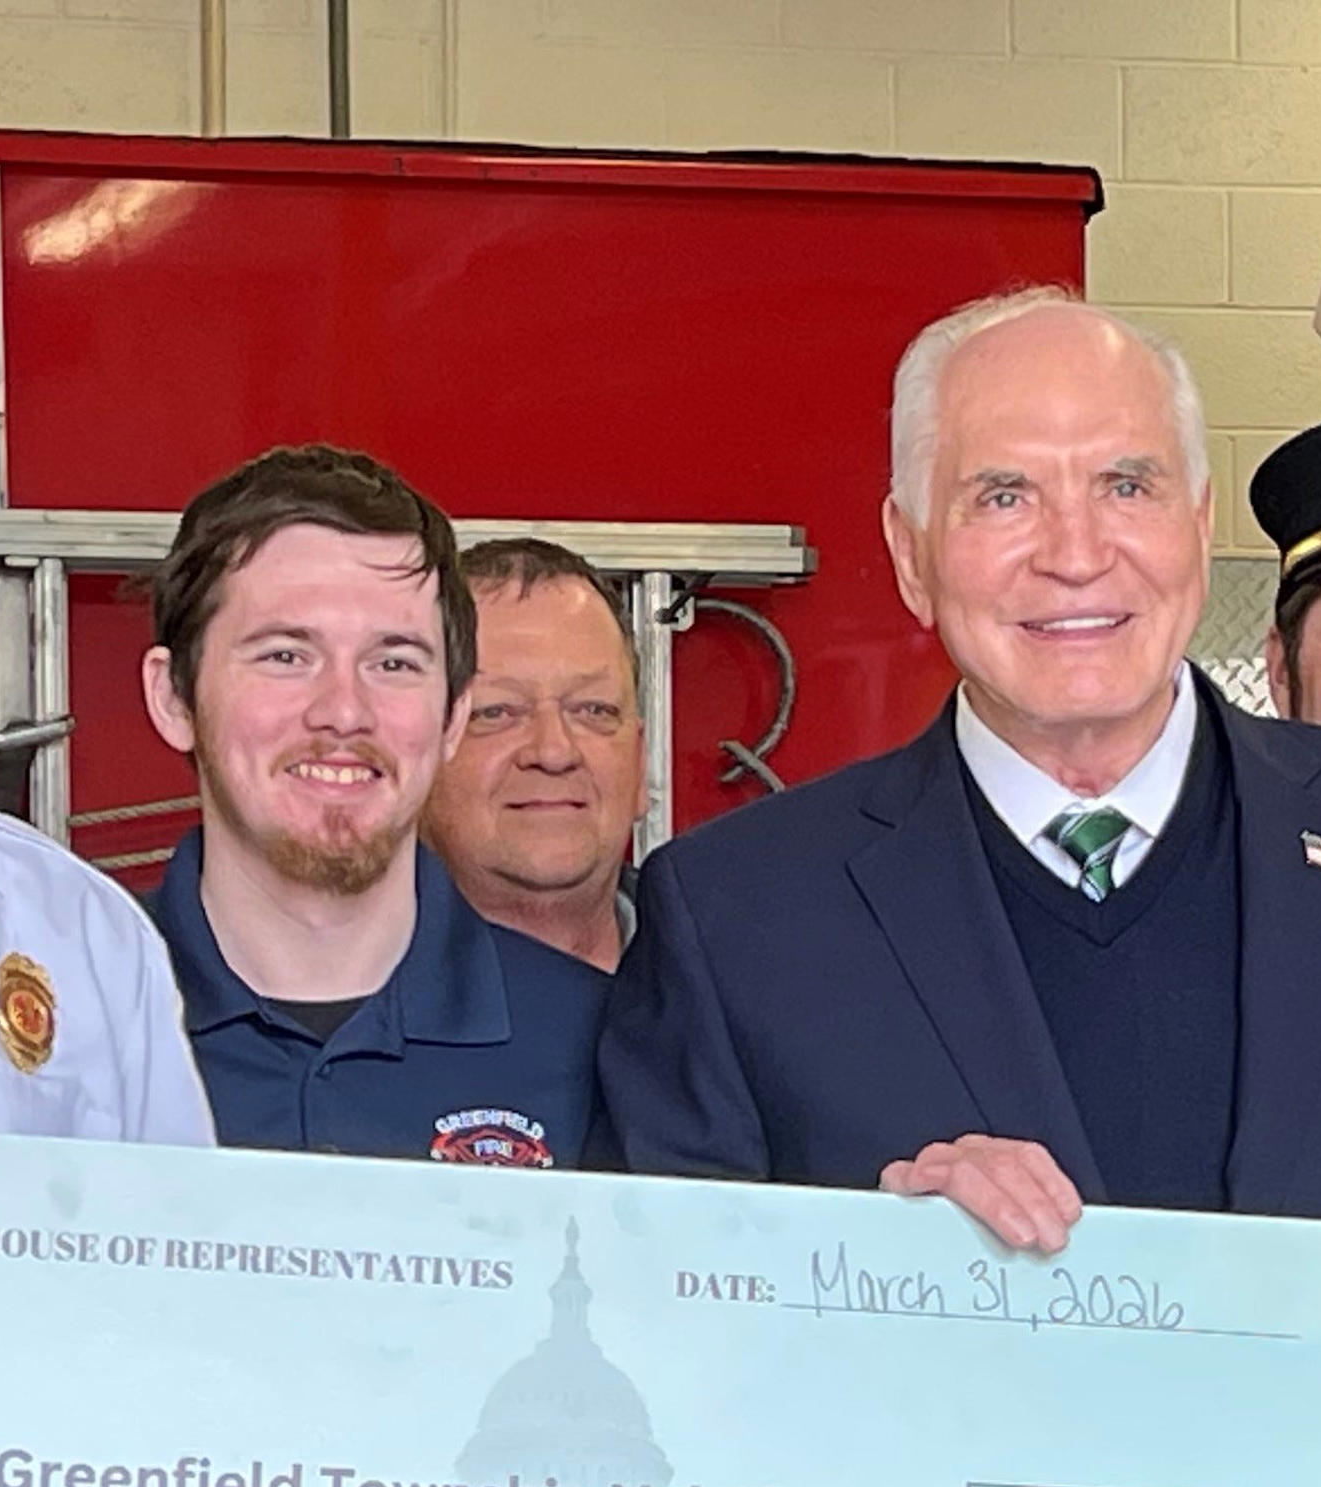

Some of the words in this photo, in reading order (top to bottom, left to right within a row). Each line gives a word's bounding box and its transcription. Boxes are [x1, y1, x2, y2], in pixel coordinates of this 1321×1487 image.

[107, 1235, 157, 1267] OF
[164, 1239, 514, 1290] REPRESENTATIVES
[675, 1270, 776, 1303] DATE:
[810, 1242, 945, 1317] March
